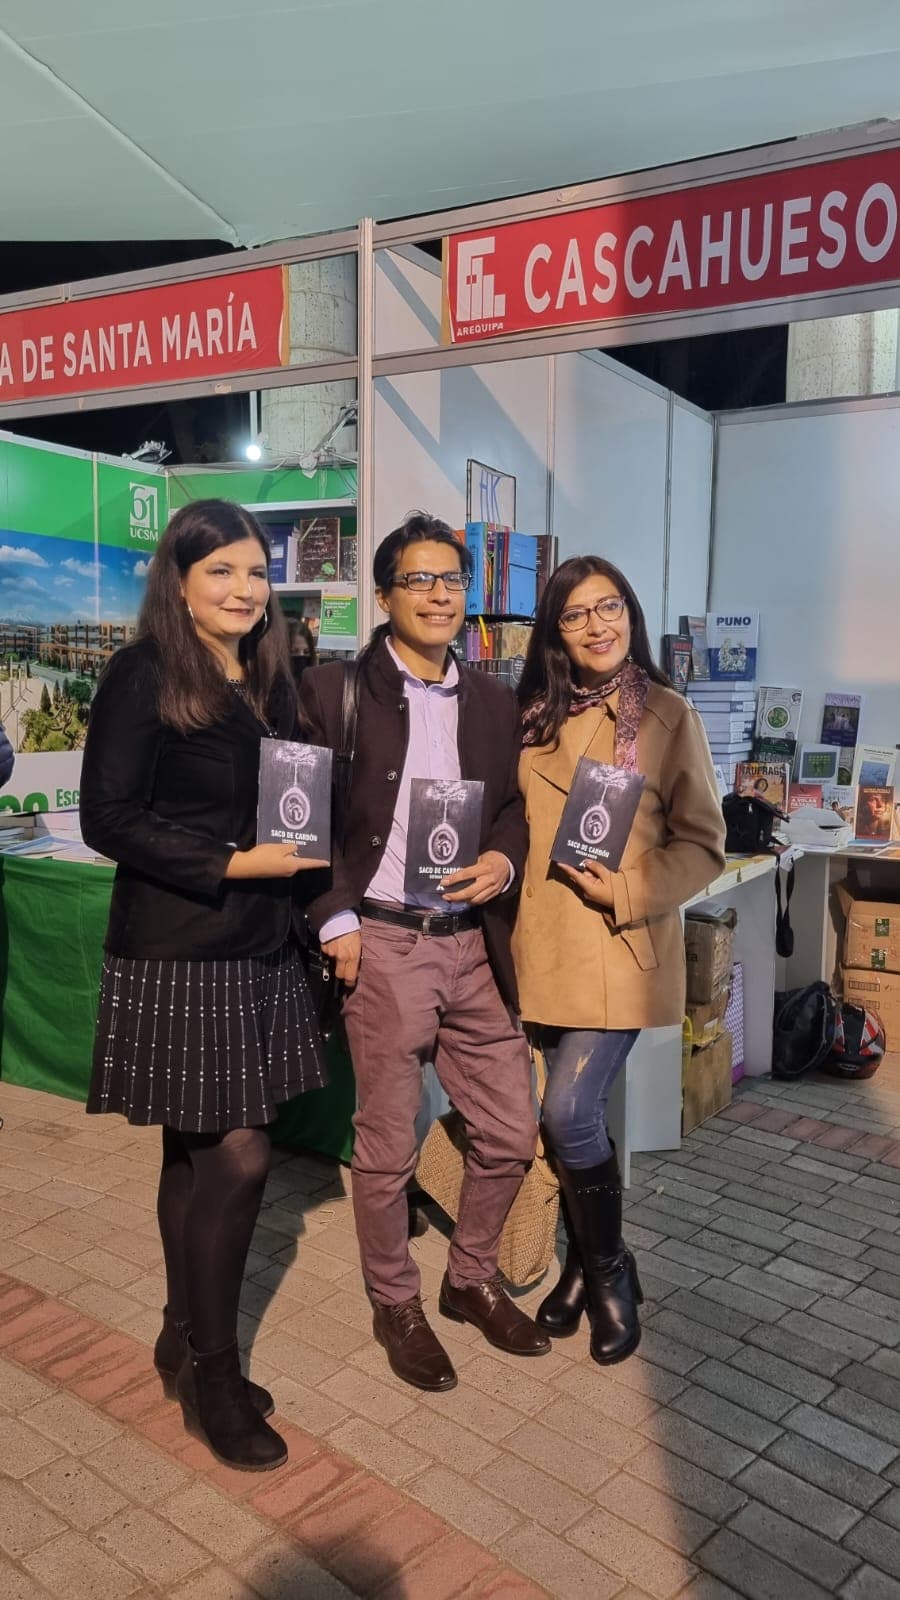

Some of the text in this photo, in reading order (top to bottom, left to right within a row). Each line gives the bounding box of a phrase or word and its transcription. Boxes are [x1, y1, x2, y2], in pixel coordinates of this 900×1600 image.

[523, 182, 898, 314] CASCAHUESO
[22, 336, 55, 382] DE
[63, 320, 152, 377] SANTA
[161, 292, 257, 363] MARÍA
[456, 322, 504, 337] AREQUIPA
[130, 527, 159, 542] UCSM
[716, 616, 751, 626] PUNO
[271, 829, 286, 838] SACO
[286, 831, 295, 839] DE
[568, 840, 580, 849] SACO
[581, 843, 588, 851] DE
